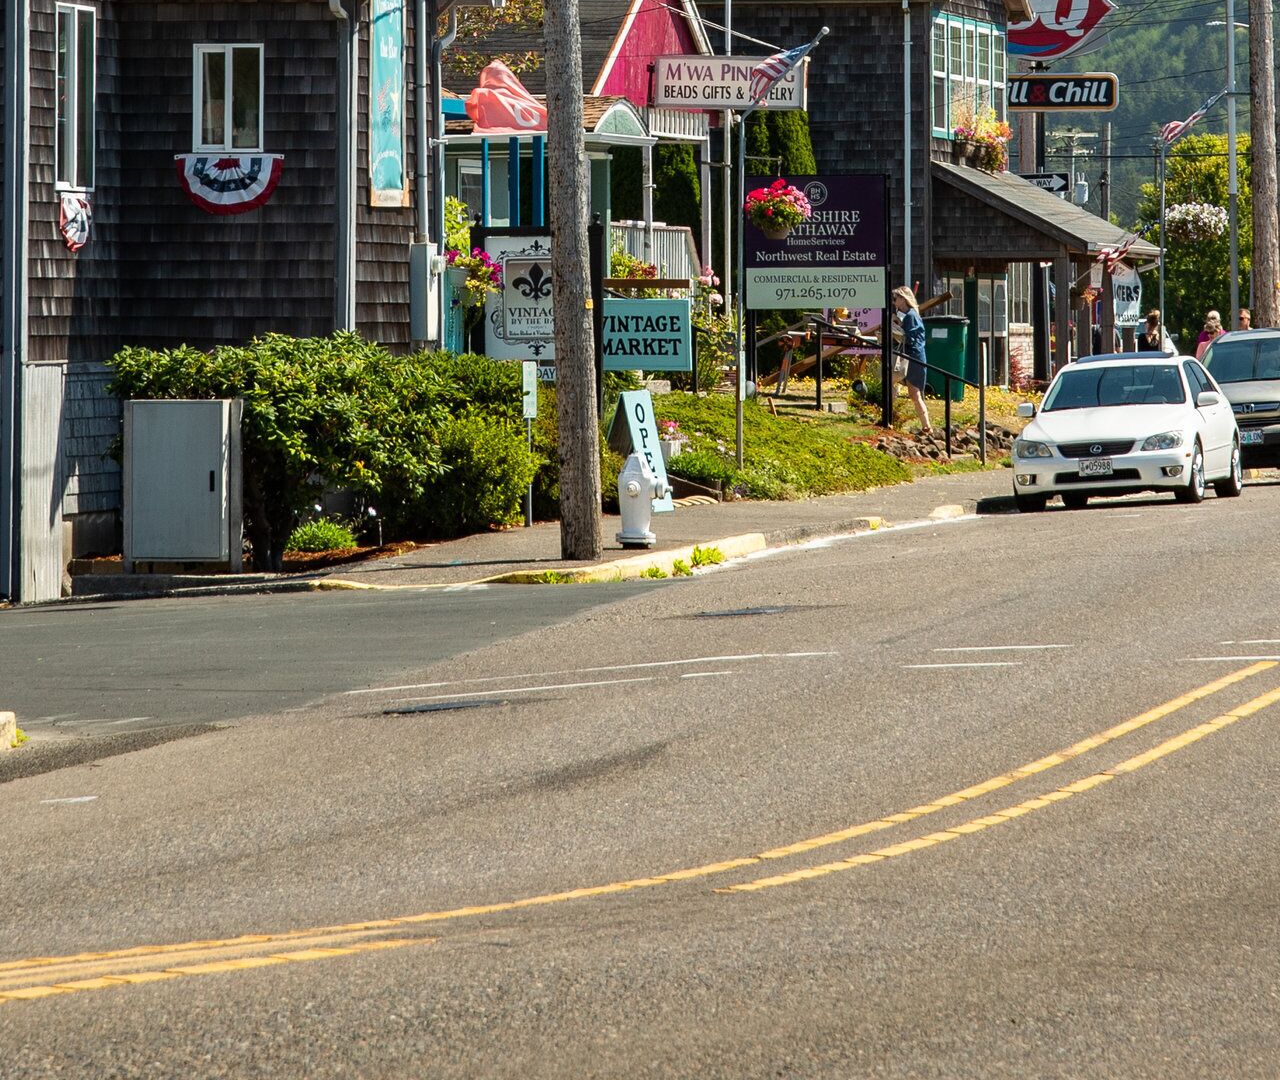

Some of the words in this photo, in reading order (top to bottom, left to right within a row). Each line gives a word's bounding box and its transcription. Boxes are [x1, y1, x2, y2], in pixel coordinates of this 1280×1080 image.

[664, 85, 698, 99] BEADS
[702, 85, 731, 100] GIFTS
[736, 87, 745, 100] &
[749, 87, 794, 102] ELRY
[1008, 81, 1028, 104] ill
[1030, 84, 1046, 102] &
[1049, 81, 1108, 103] Chill
[790, 224, 856, 236] ATHAWAY
[786, 237, 846, 246] HomeServices
[756, 251, 812, 261] Northwest
[815, 251, 839, 261] Real
[843, 251, 877, 261] Estate
[753, 275, 811, 284] COMMERCIAL
[814, 275, 820, 283] &
[821, 274, 879, 283] RESIDENTIAL
[775, 286, 857, 301] 971.265.1070
[508, 307, 554, 318] VINTA
[634, 403, 657, 478] OPE
